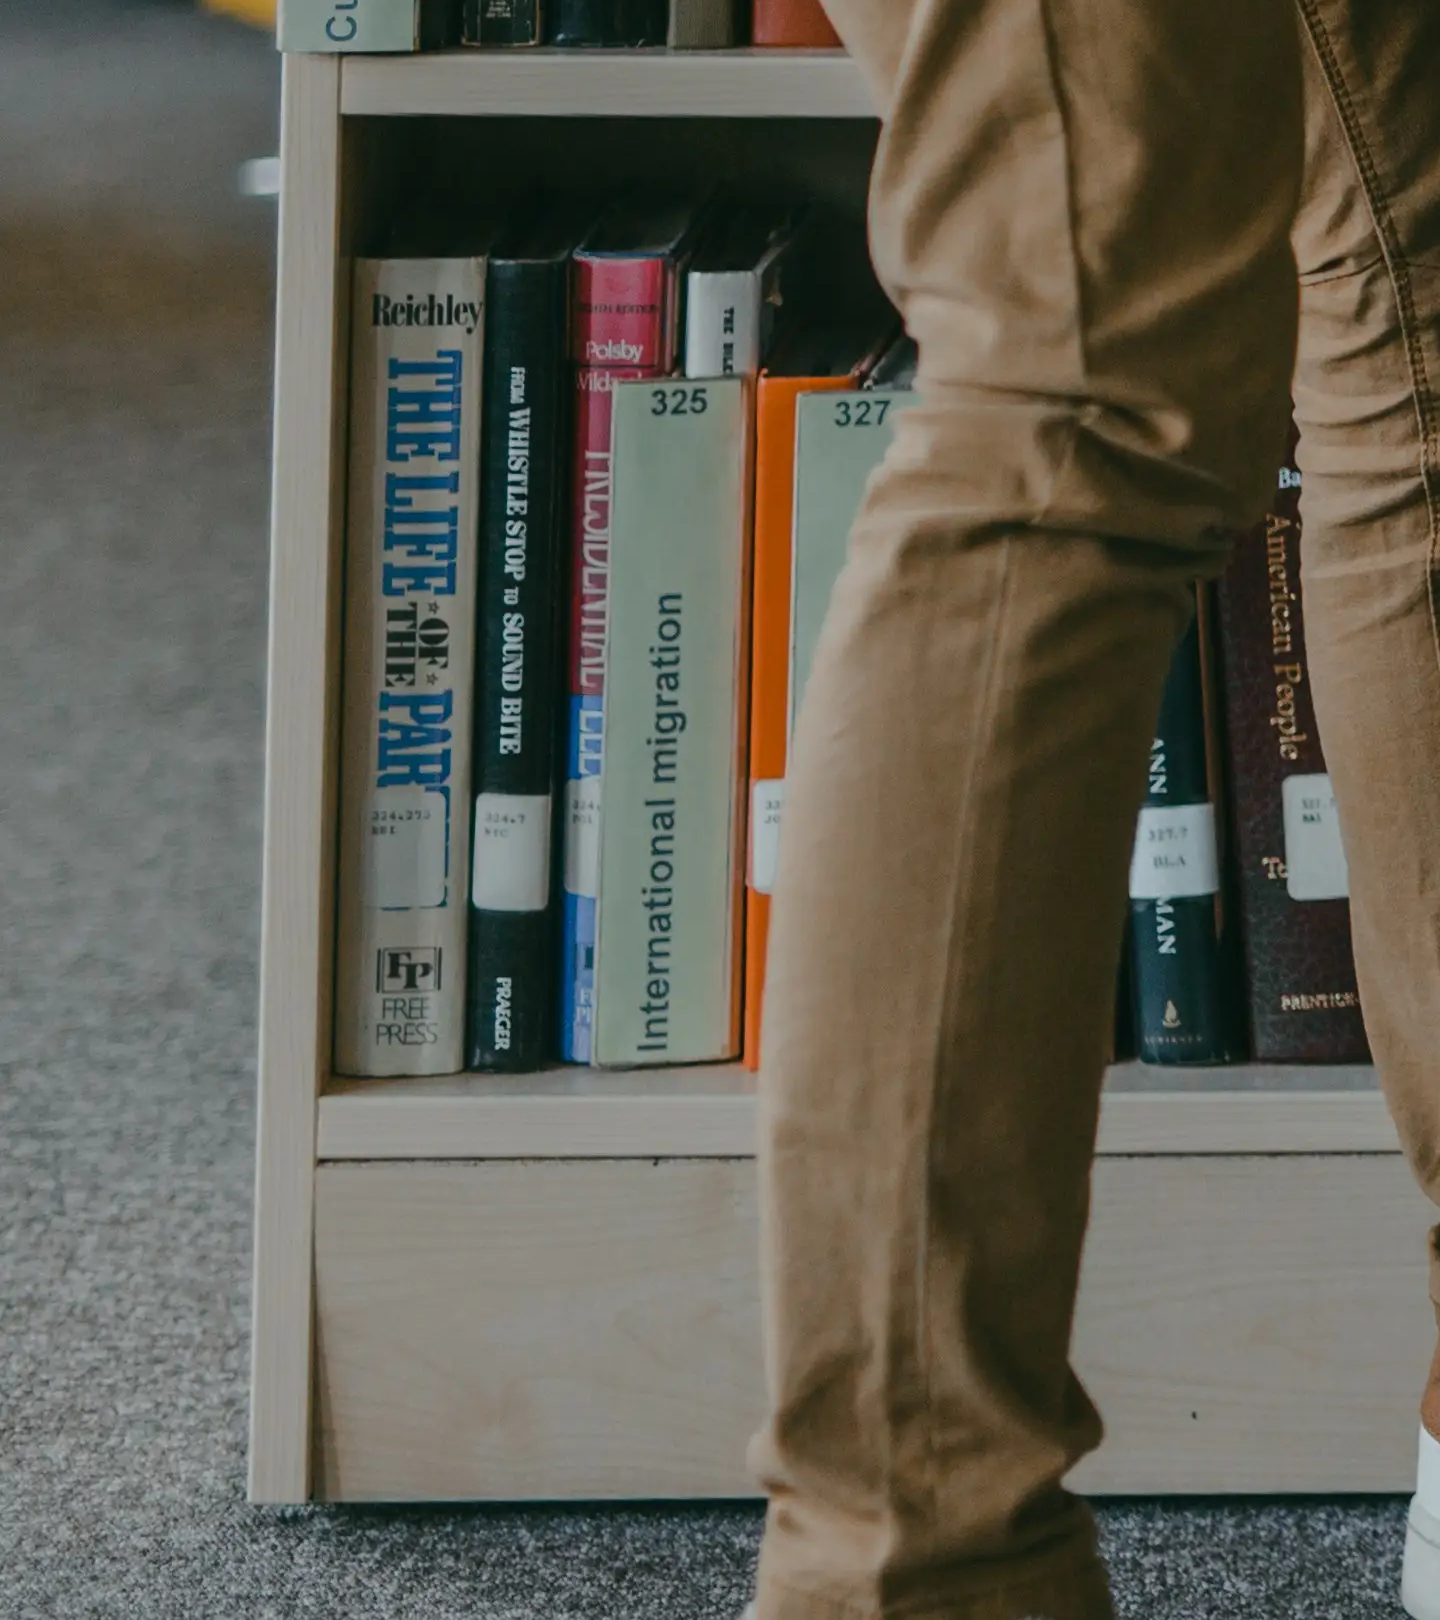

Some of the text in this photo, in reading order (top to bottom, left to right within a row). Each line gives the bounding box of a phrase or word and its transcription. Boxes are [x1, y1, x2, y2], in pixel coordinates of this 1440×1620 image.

[371, 293, 483, 336] Reichley
[585, 338, 643, 364] Polsby
[651, 387, 709, 416] 325
[835, 400, 889, 427] 327
[379, 348, 465, 599] THE LIFE
[498, 366, 530, 755] FROM WHISTLE STOP TO SOUND BITE
[385, 600, 417, 688] THE
[420, 617, 453, 669] OF
[1264, 513, 1308, 761] American People
[636, 594, 686, 1051] International migration
[375, 1022, 439, 1046] PRESS
[381, 997, 434, 1020] FREE
[493, 976, 512, 1052] PRAEGER
